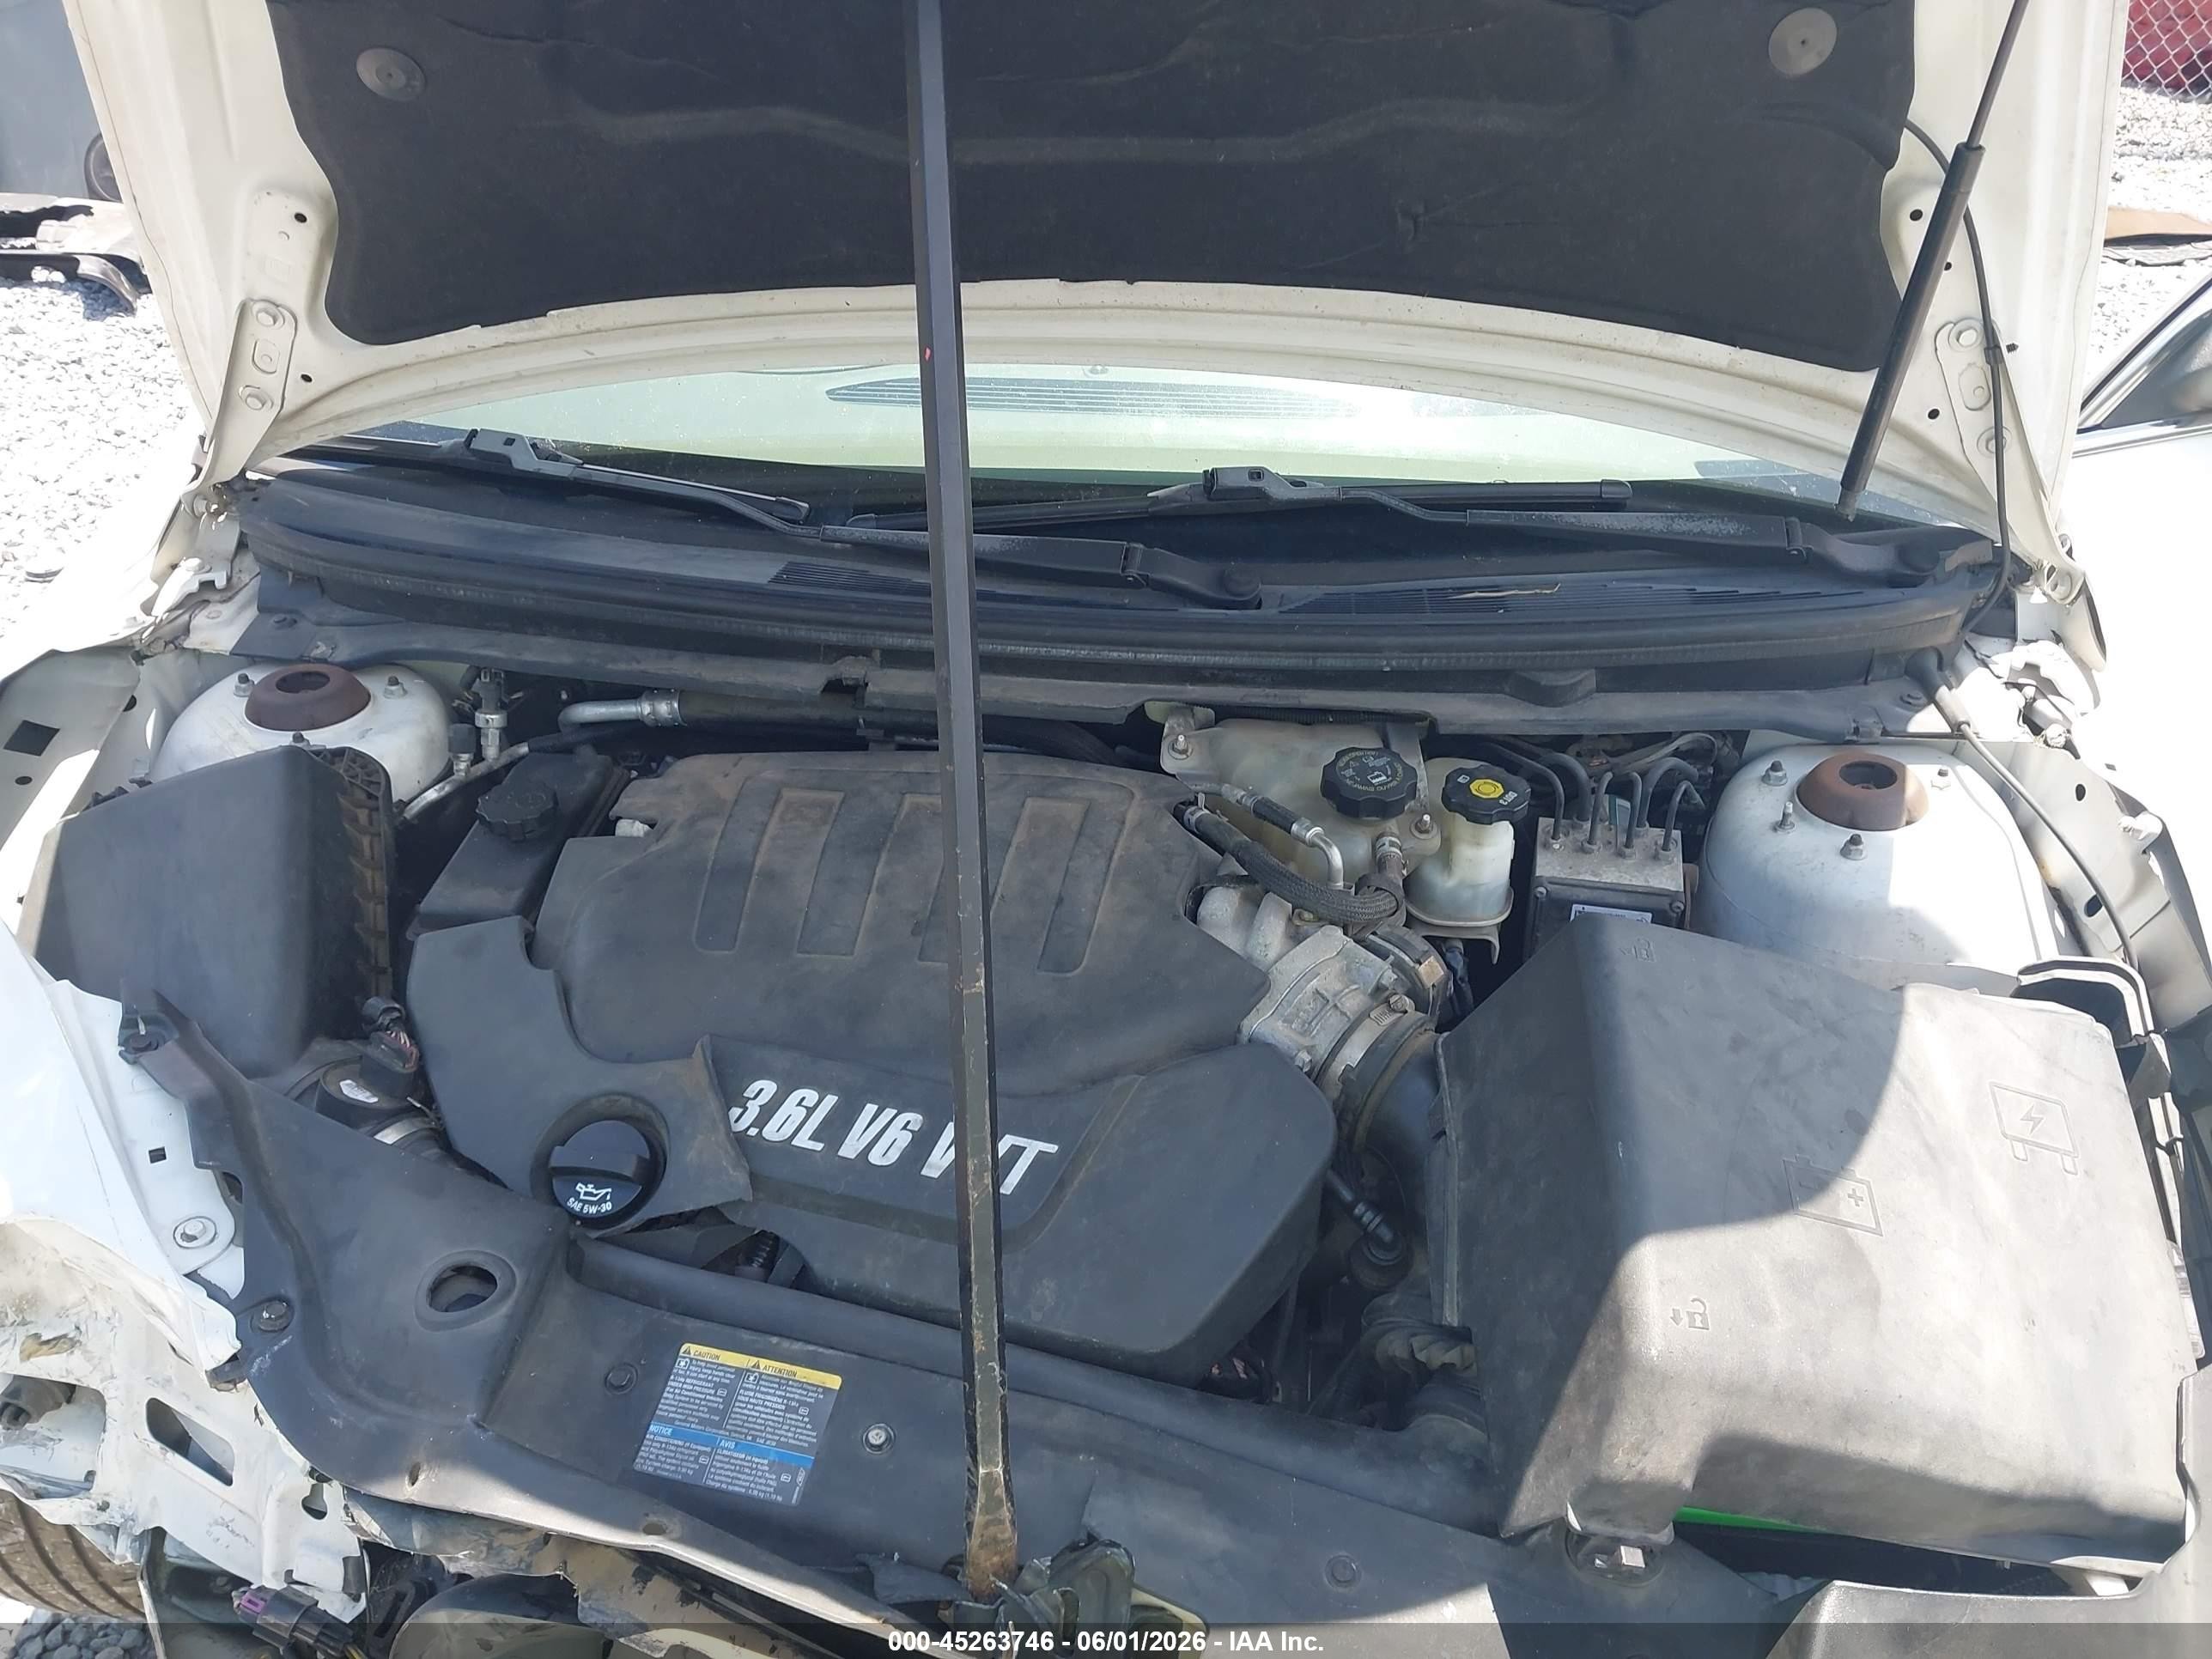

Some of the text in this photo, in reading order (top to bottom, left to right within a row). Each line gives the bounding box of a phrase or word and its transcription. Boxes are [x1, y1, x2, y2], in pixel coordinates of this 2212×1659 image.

[728, 1079, 838, 1152] 3.6L
[837, 1103, 924, 1167] V6
[567, 1198, 612, 1214] SAE 5W-30
[692, 1349, 720, 1360] CAUTION
[761, 1364, 798, 1377] ATTENTION
[647, 1423, 673, 1436] NOTICE
[720, 1439, 737, 1449] AVIS
